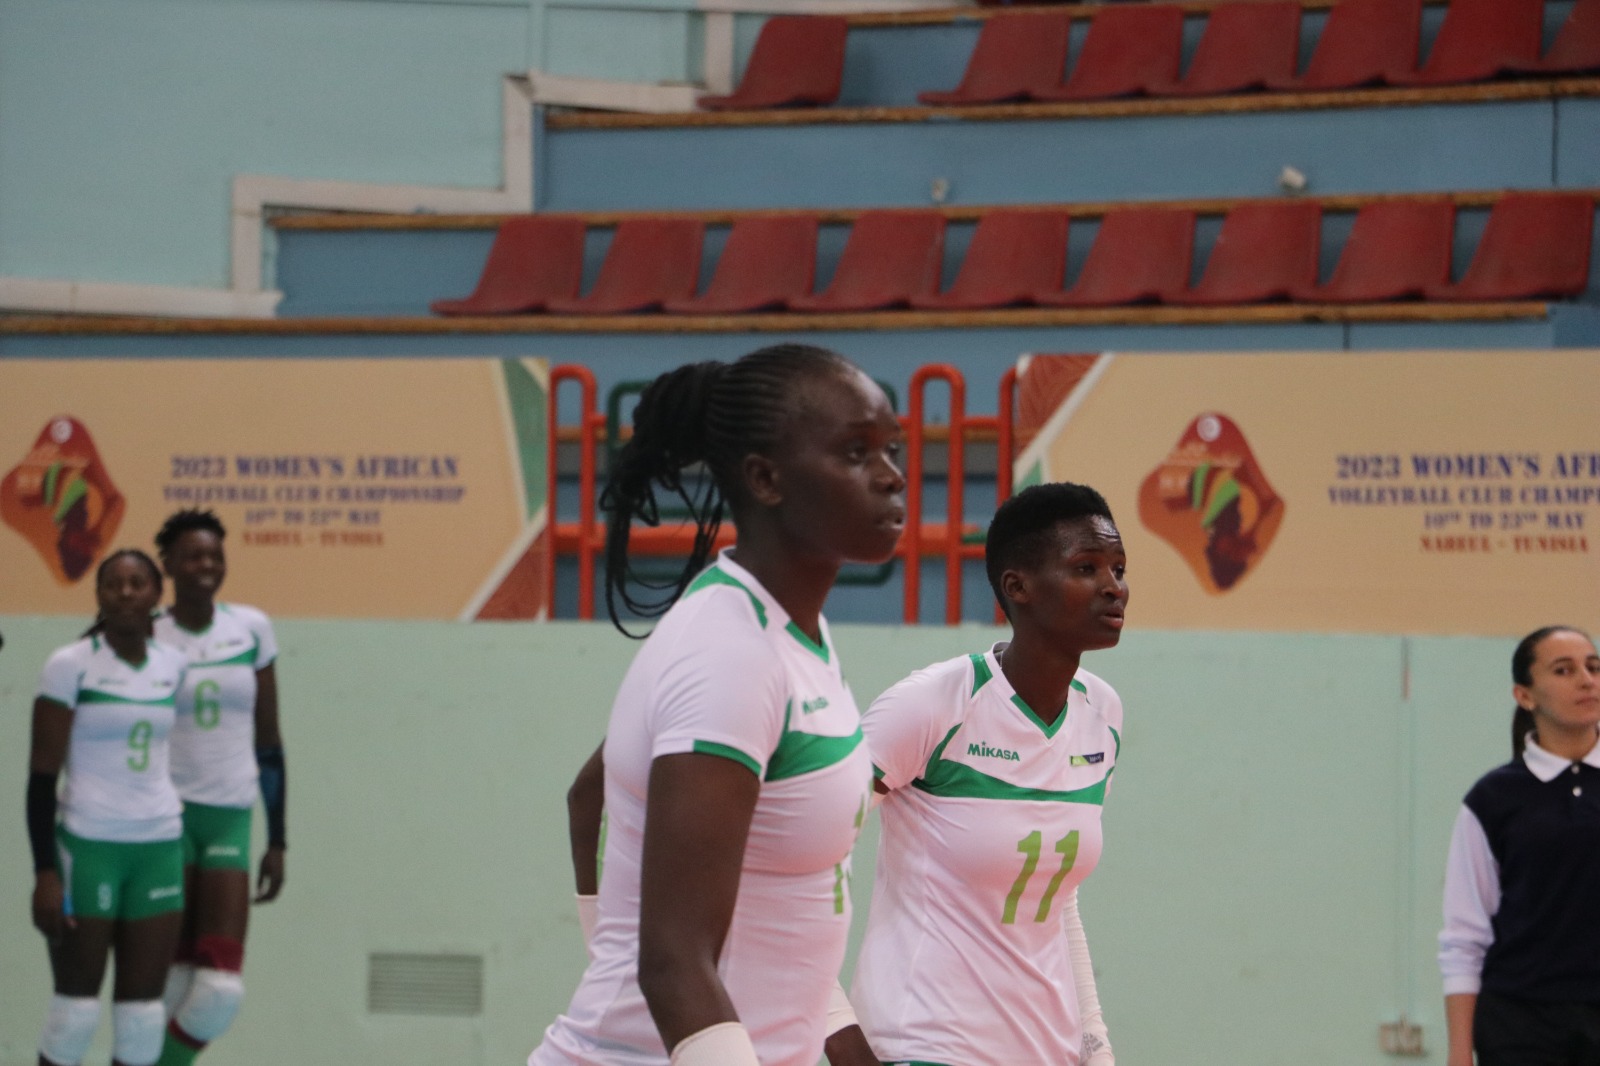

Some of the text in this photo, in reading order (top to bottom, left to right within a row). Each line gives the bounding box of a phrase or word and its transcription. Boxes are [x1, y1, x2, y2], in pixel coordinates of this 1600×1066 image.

[172, 456, 458, 478] 2023 WOMEN'S AFRICAN
[1336, 455, 1400, 478] 2023
[1411, 454, 1540, 478] WOMEN'S
[163, 485, 466, 504] VOLLEYBALL CLUB CHAMPIONSHIP
[1328, 485, 1450, 505] VOLLEYBALL
[1458, 485, 1512, 505] CLUB
[1469, 511, 1493, 530] TO
[1546, 511, 1584, 530] MAY
[1420, 535, 1490, 553] NABEUL
[1513, 535, 1588, 553] TUNISIA
[193, 678, 221, 731] 6
[127, 720, 154, 772] 9
[1000, 830, 1080, 925] 11
